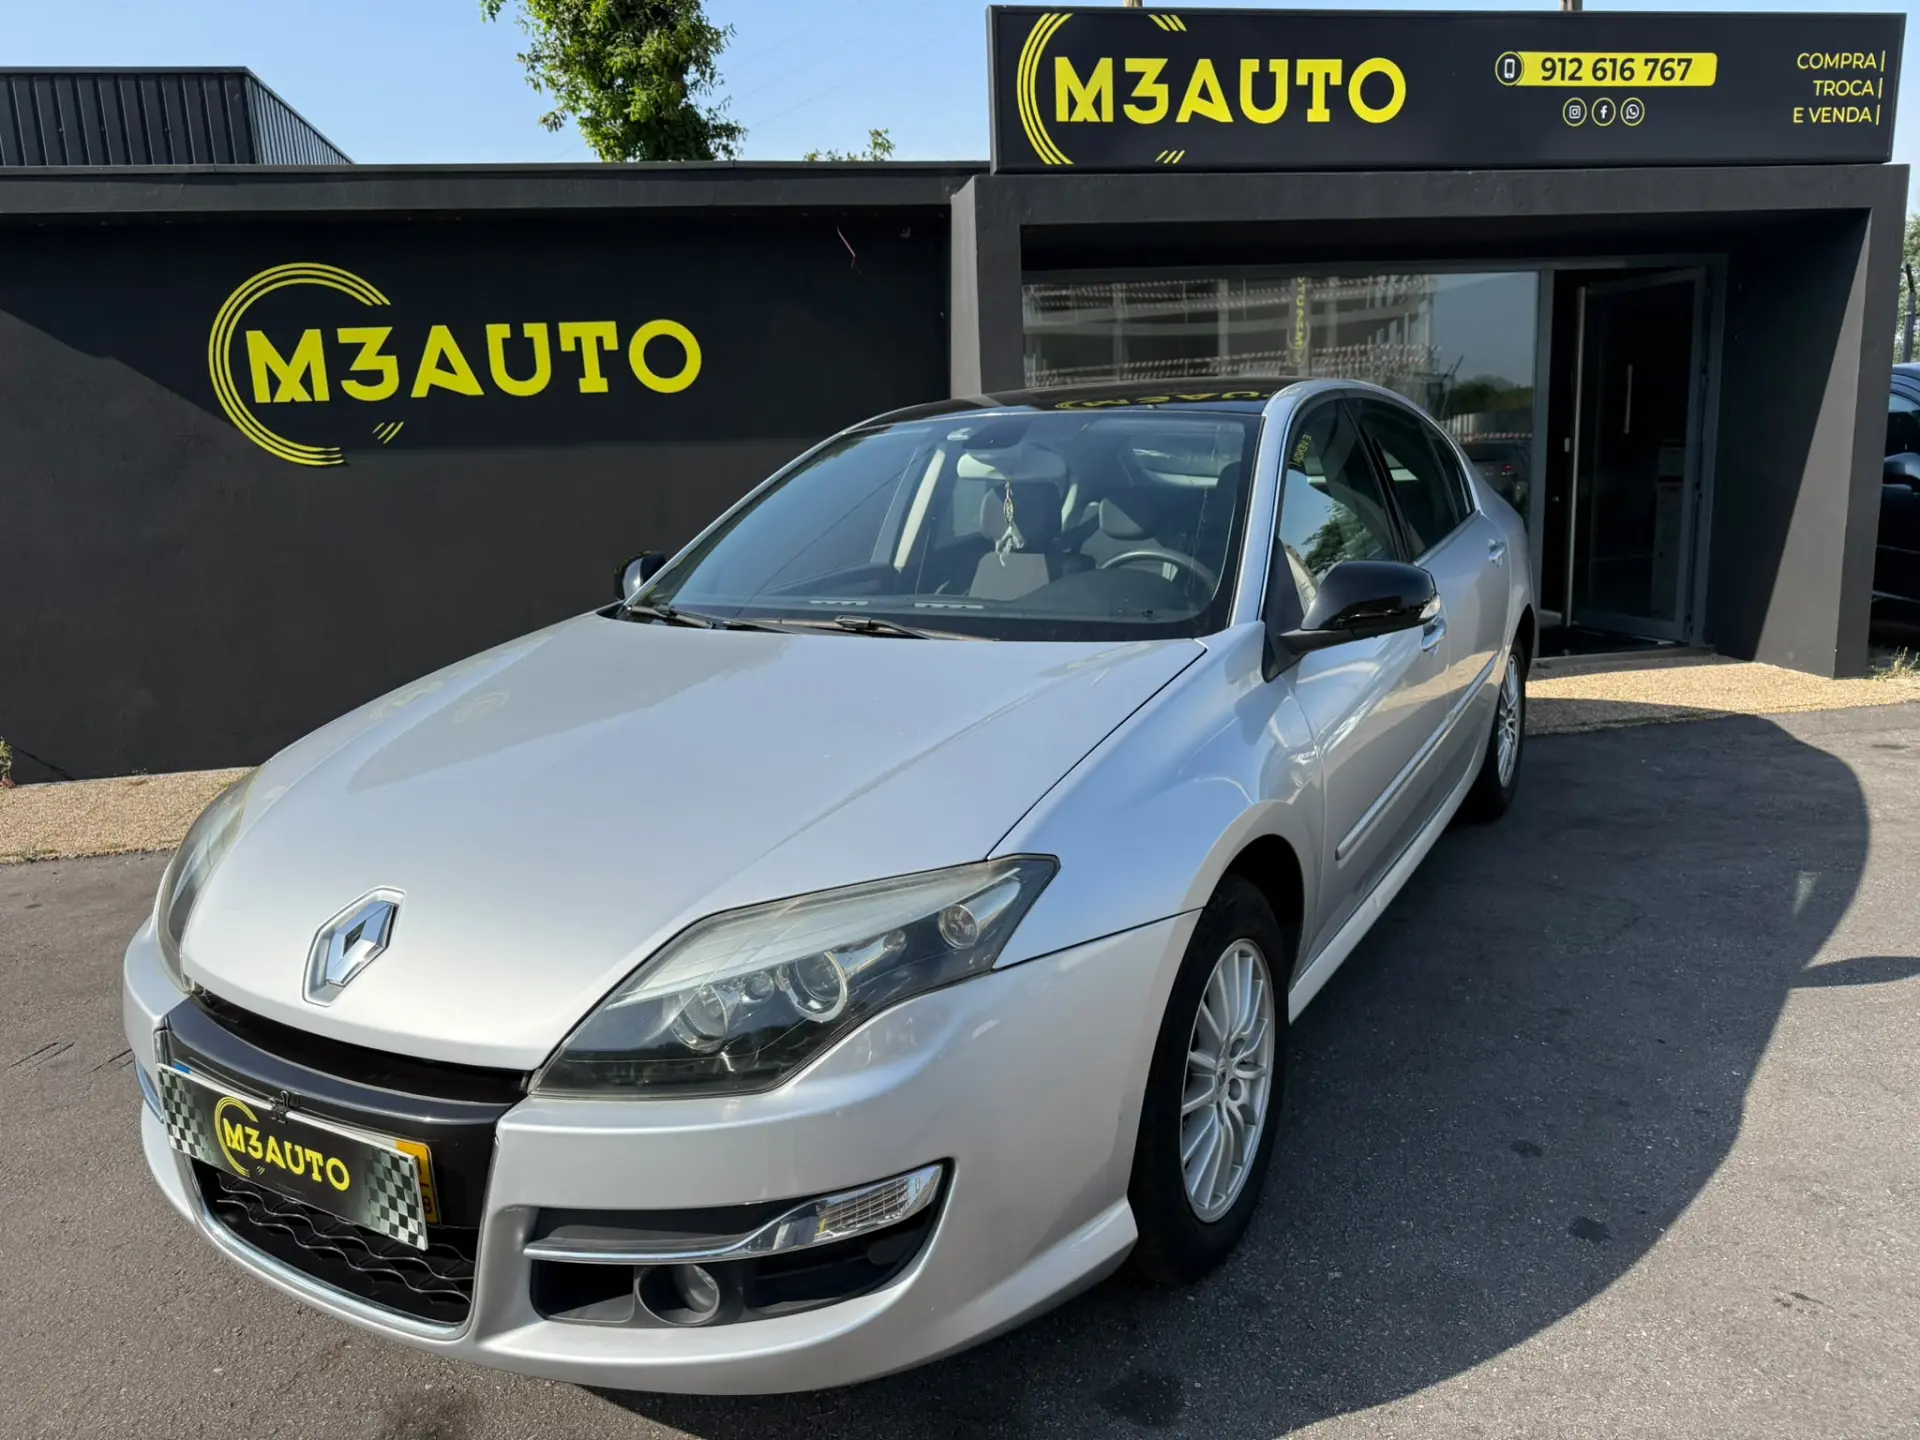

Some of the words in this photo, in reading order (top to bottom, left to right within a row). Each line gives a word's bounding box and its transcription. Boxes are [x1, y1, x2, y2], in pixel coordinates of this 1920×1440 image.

[1540, 57, 1584, 82] 912
[1591, 57, 1636, 82] 616
[1643, 57, 1693, 82] 767
[1796, 52, 1877, 70] COMPRA
[1055, 57, 1407, 125] M3AUTO
[1813, 80, 1875, 97] TROCA
[1793, 107, 1804, 124] E
[1809, 107, 1872, 124] VENDA
[247, 320, 703, 404] M3AUTO
[223, 1117, 351, 1192] M3AUTO
